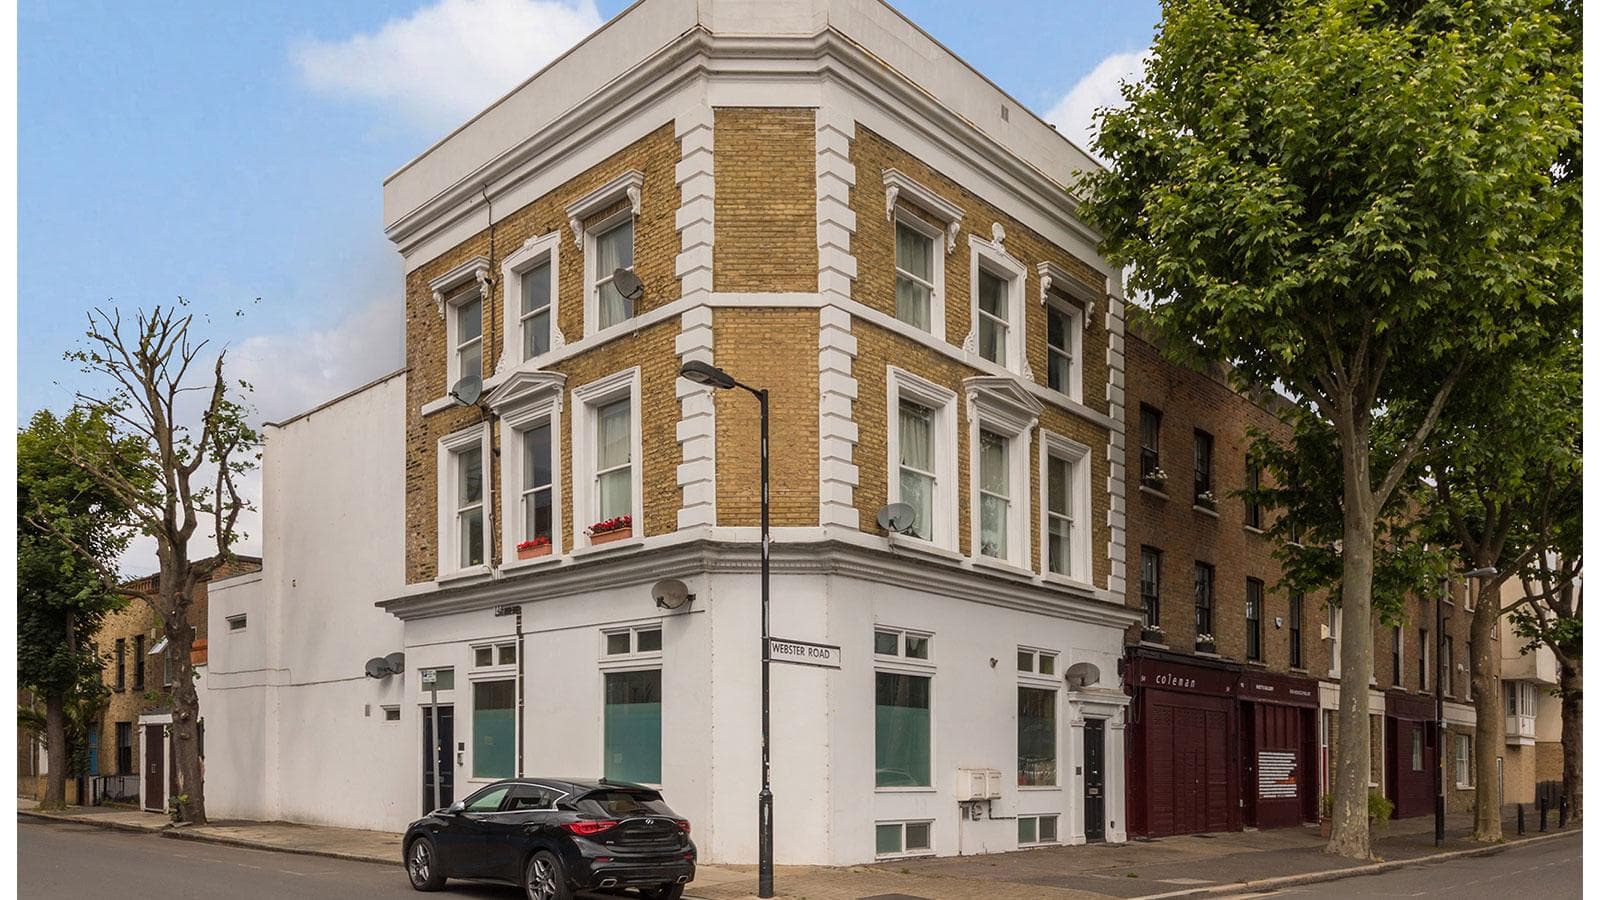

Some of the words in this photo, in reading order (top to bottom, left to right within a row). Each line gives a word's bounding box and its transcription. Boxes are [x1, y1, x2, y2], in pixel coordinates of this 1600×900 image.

[772, 642, 805, 656] WEBSTER
[808, 647, 830, 659] ROAD
[1155, 673, 1196, 688] coleman
